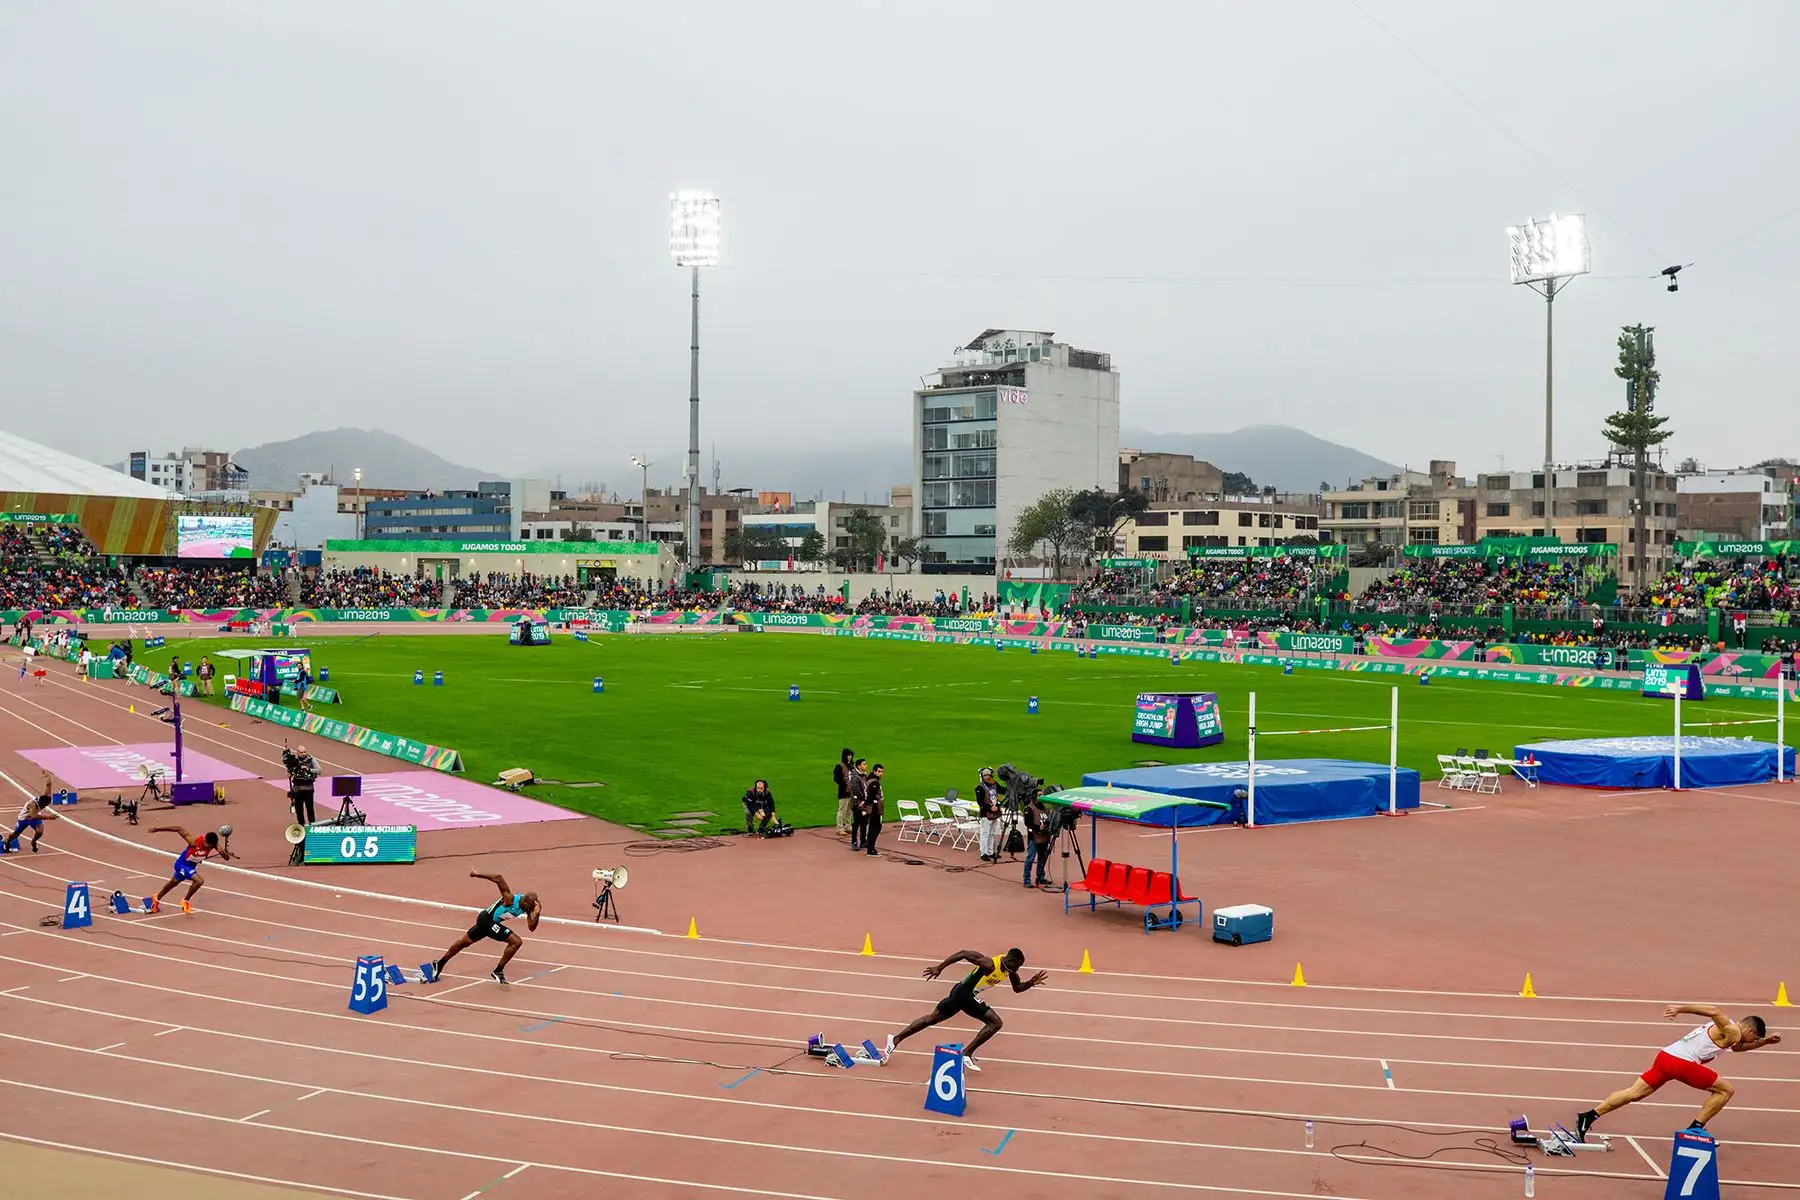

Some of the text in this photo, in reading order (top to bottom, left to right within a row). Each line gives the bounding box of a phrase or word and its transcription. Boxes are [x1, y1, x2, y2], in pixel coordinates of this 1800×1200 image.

[461, 543, 526, 551] JUGAMOS TODOS
[1432, 546, 1477, 555] PANAM SPORTS
[1530, 546, 1588, 554] JUGAMOS TODOS
[1645, 677, 1667, 686] 2019
[1140, 694, 1154, 702] LYNX
[1029, 700, 1038, 708] 40
[1137, 712, 1164, 721] DECATHLON
[1136, 719, 1164, 729] HIGH JUMP
[340, 836, 379, 858] 0.5
[67, 890, 88, 919] 4
[934, 1059, 958, 1101] 6
[1677, 1146, 1712, 1196] 7
